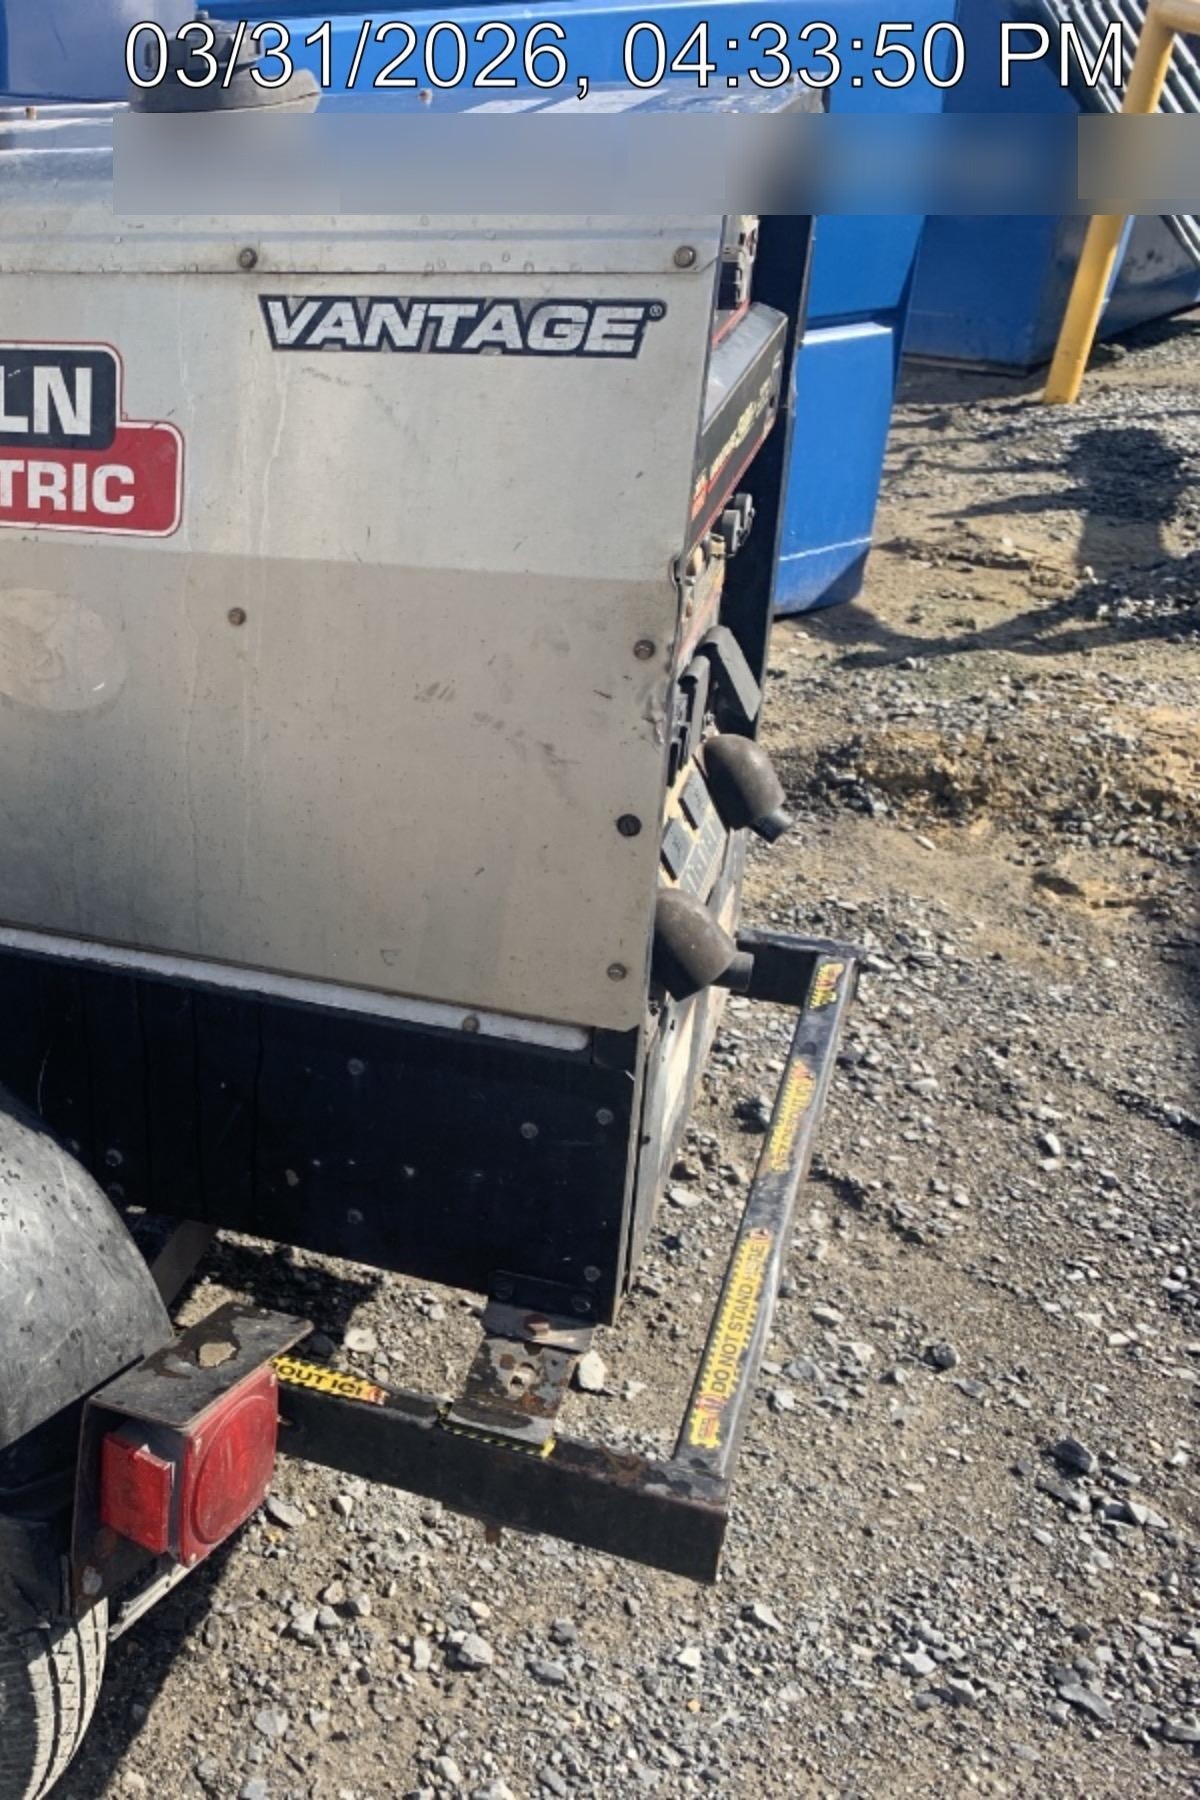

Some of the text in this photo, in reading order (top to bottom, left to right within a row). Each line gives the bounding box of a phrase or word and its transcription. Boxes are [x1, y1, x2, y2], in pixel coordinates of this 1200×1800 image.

[728, 1285, 754, 1333] STAND
[720, 1334, 738, 1367] NOT
[331, 1379, 363, 1396] ICI
[711, 1369, 731, 1393] DO
